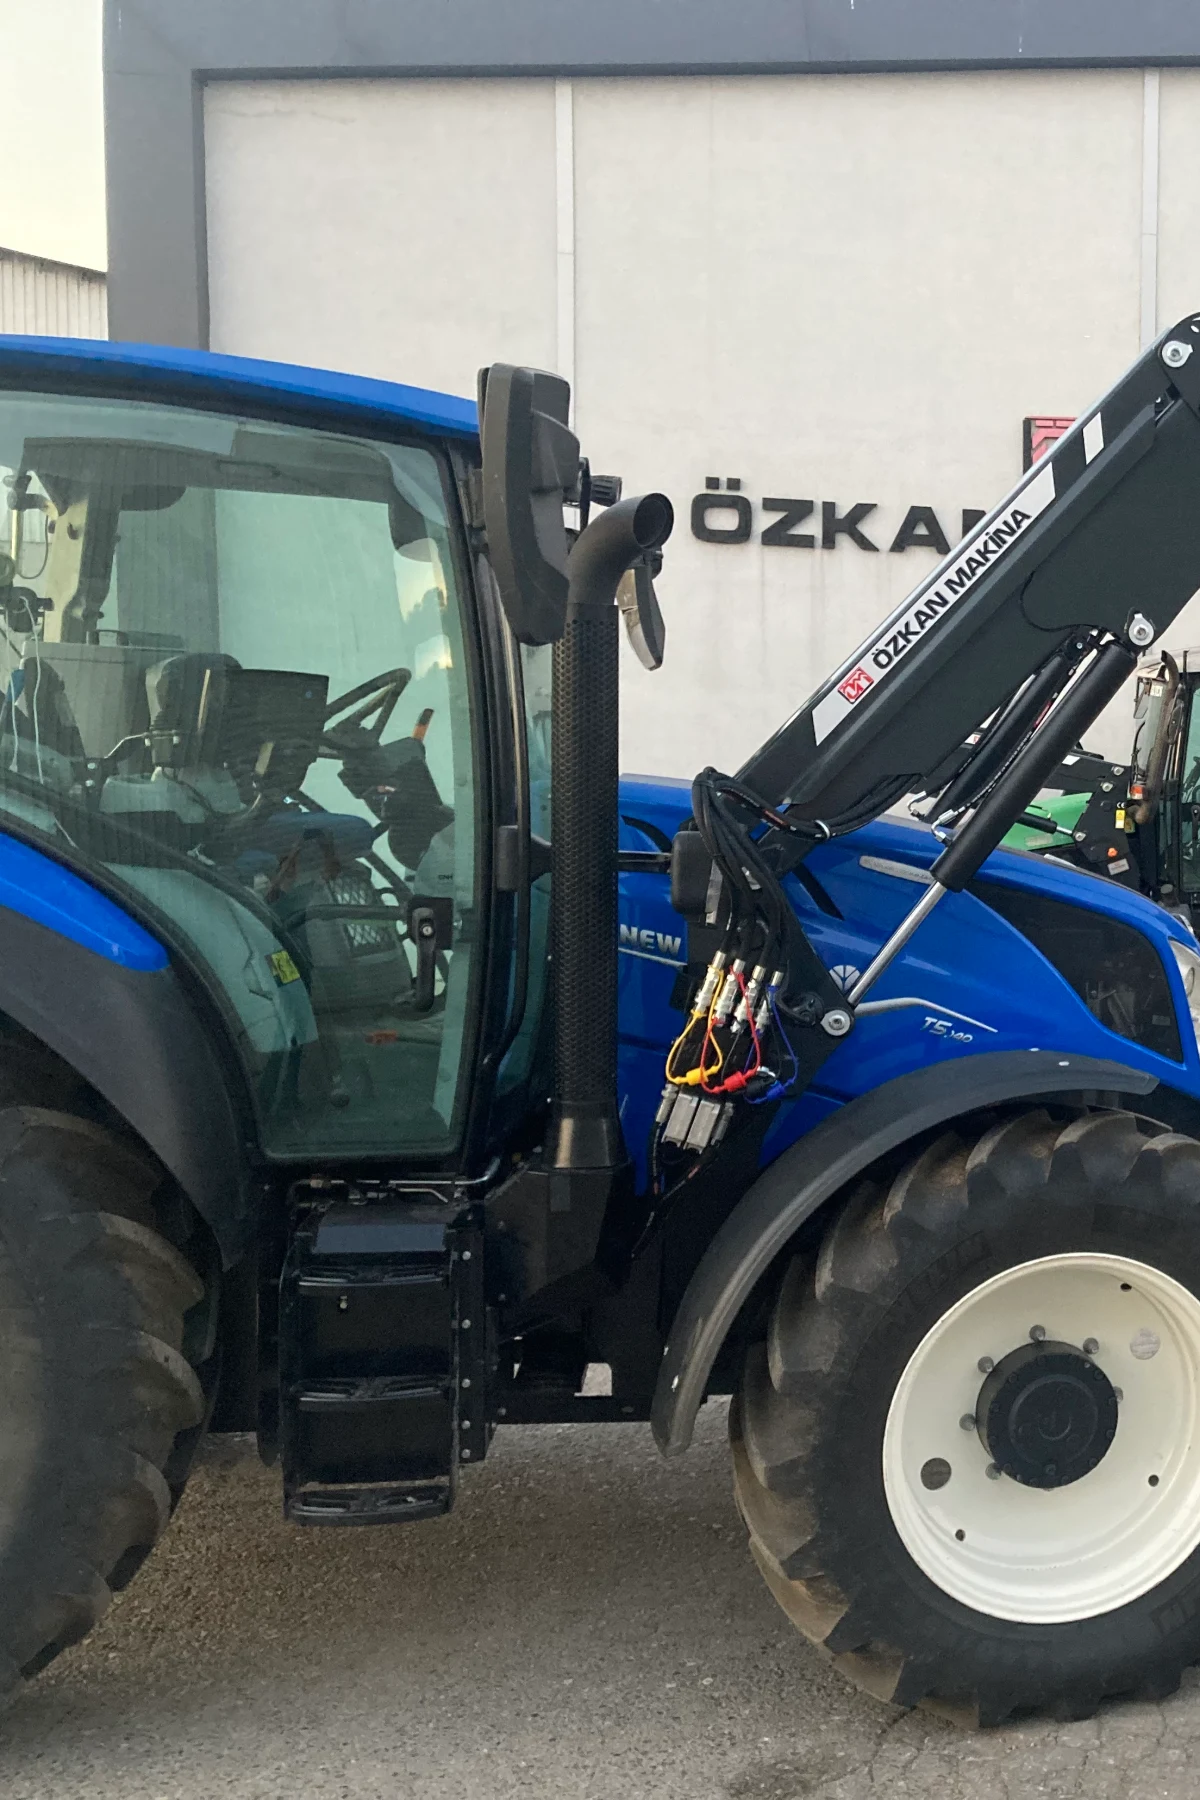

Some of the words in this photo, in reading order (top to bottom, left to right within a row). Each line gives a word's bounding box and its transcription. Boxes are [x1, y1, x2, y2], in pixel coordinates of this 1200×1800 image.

[872, 591, 950, 670] ÖZKAN
[944, 509, 1032, 595] MAKİNA
[620, 924, 681, 956] NEW
